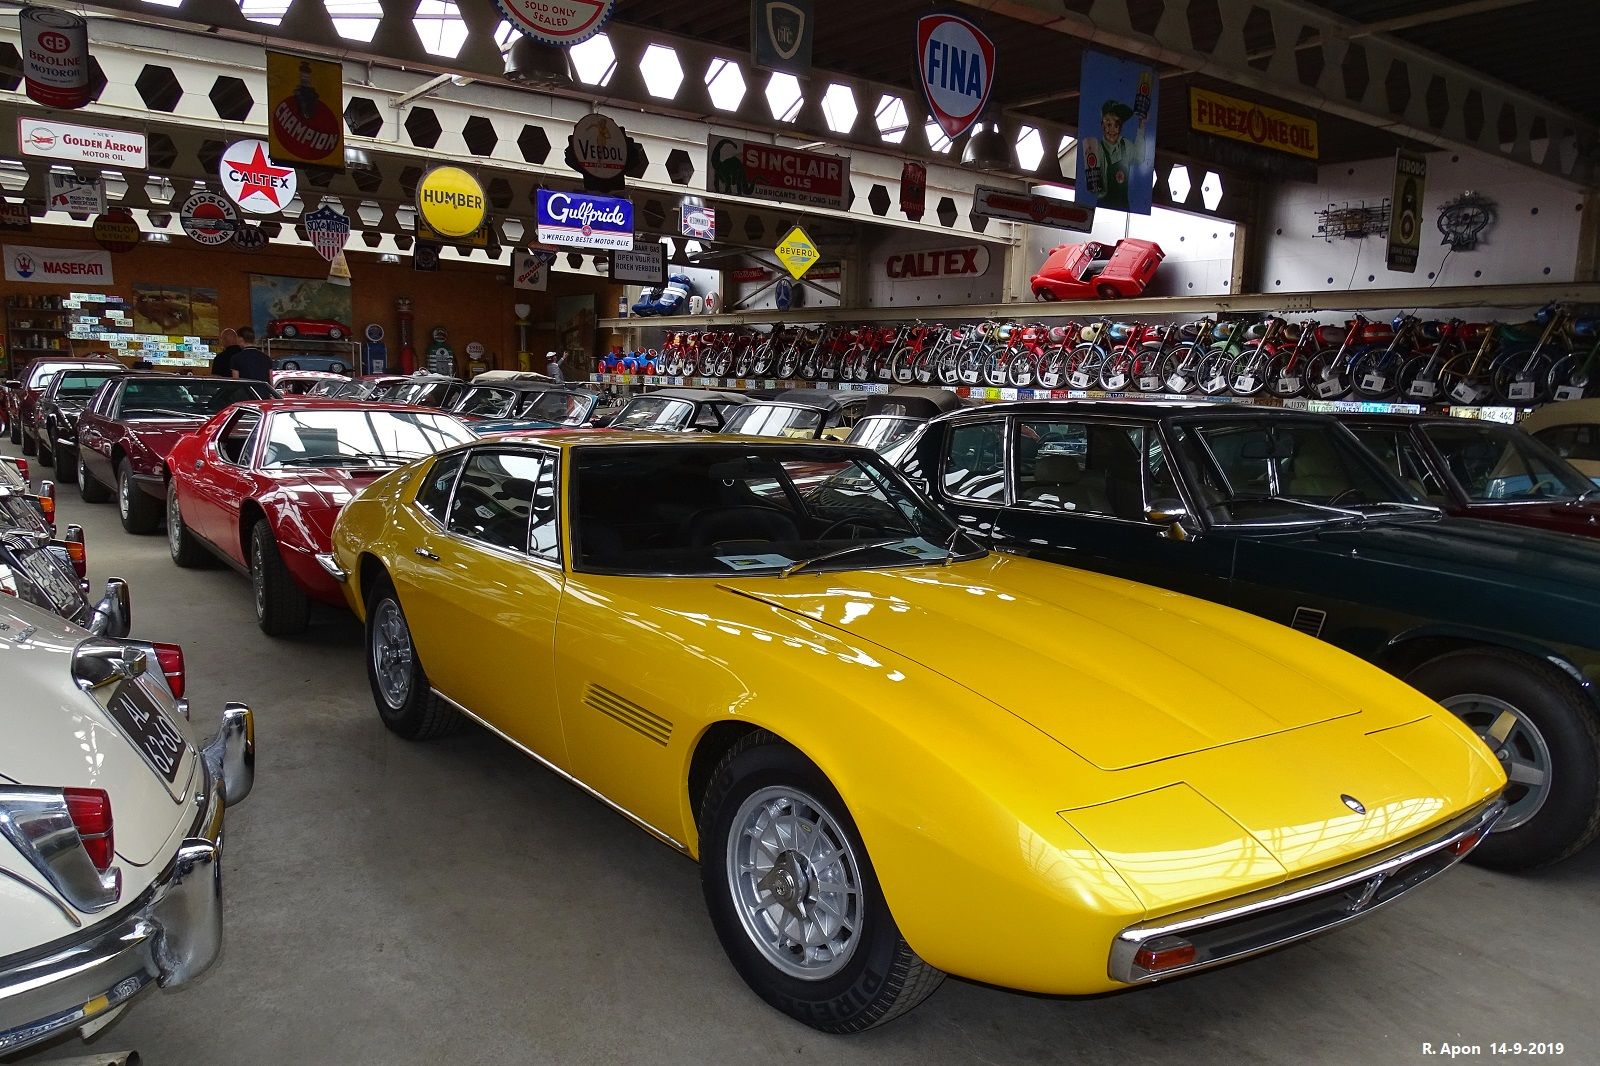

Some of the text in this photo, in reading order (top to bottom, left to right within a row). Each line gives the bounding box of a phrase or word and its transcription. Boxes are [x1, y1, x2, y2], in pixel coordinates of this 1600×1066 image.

[525, 1, 576, 17] SOLD ONLY
[533, 12, 568, 26] SEALED
[42, 35, 66, 50] GB
[29, 50, 80, 66] BROLINE
[928, 39, 982, 100] FINA
[275, 102, 339, 151] CHAMPION
[63, 134, 143, 154] GOLDEN ARROW
[578, 139, 622, 161] VEEDOL
[82, 150, 125, 161] MOTOR OIL
[746, 149, 840, 180] SINCLAIR
[229, 170, 289, 190] CALTEX
[783, 175, 812, 189] OILS
[424, 189, 482, 210] HUMBER
[754, 188, 796, 200] LUBRICANTS
[809, 195, 826, 204] LONG
[828, 199, 841, 207] LIFE
[184, 195, 233, 217] HUDSON
[547, 193, 625, 226] Gulfpride
[97, 224, 137, 234] DUNLOP
[190, 230, 230, 244] REGULAR
[546, 234, 574, 242] WERELDS
[575, 236, 593, 244] BESTE
[594, 238, 614, 246] MOTOR
[618, 254, 634, 262] OPEN
[635, 255, 651, 263] VUUR
[780, 247, 817, 258] BEVEROL
[43, 262, 104, 276] MASERATI
[616, 263, 634, 271] ROKEN
[886, 248, 978, 278] CALTEX
[118, 692, 150, 731] AL
